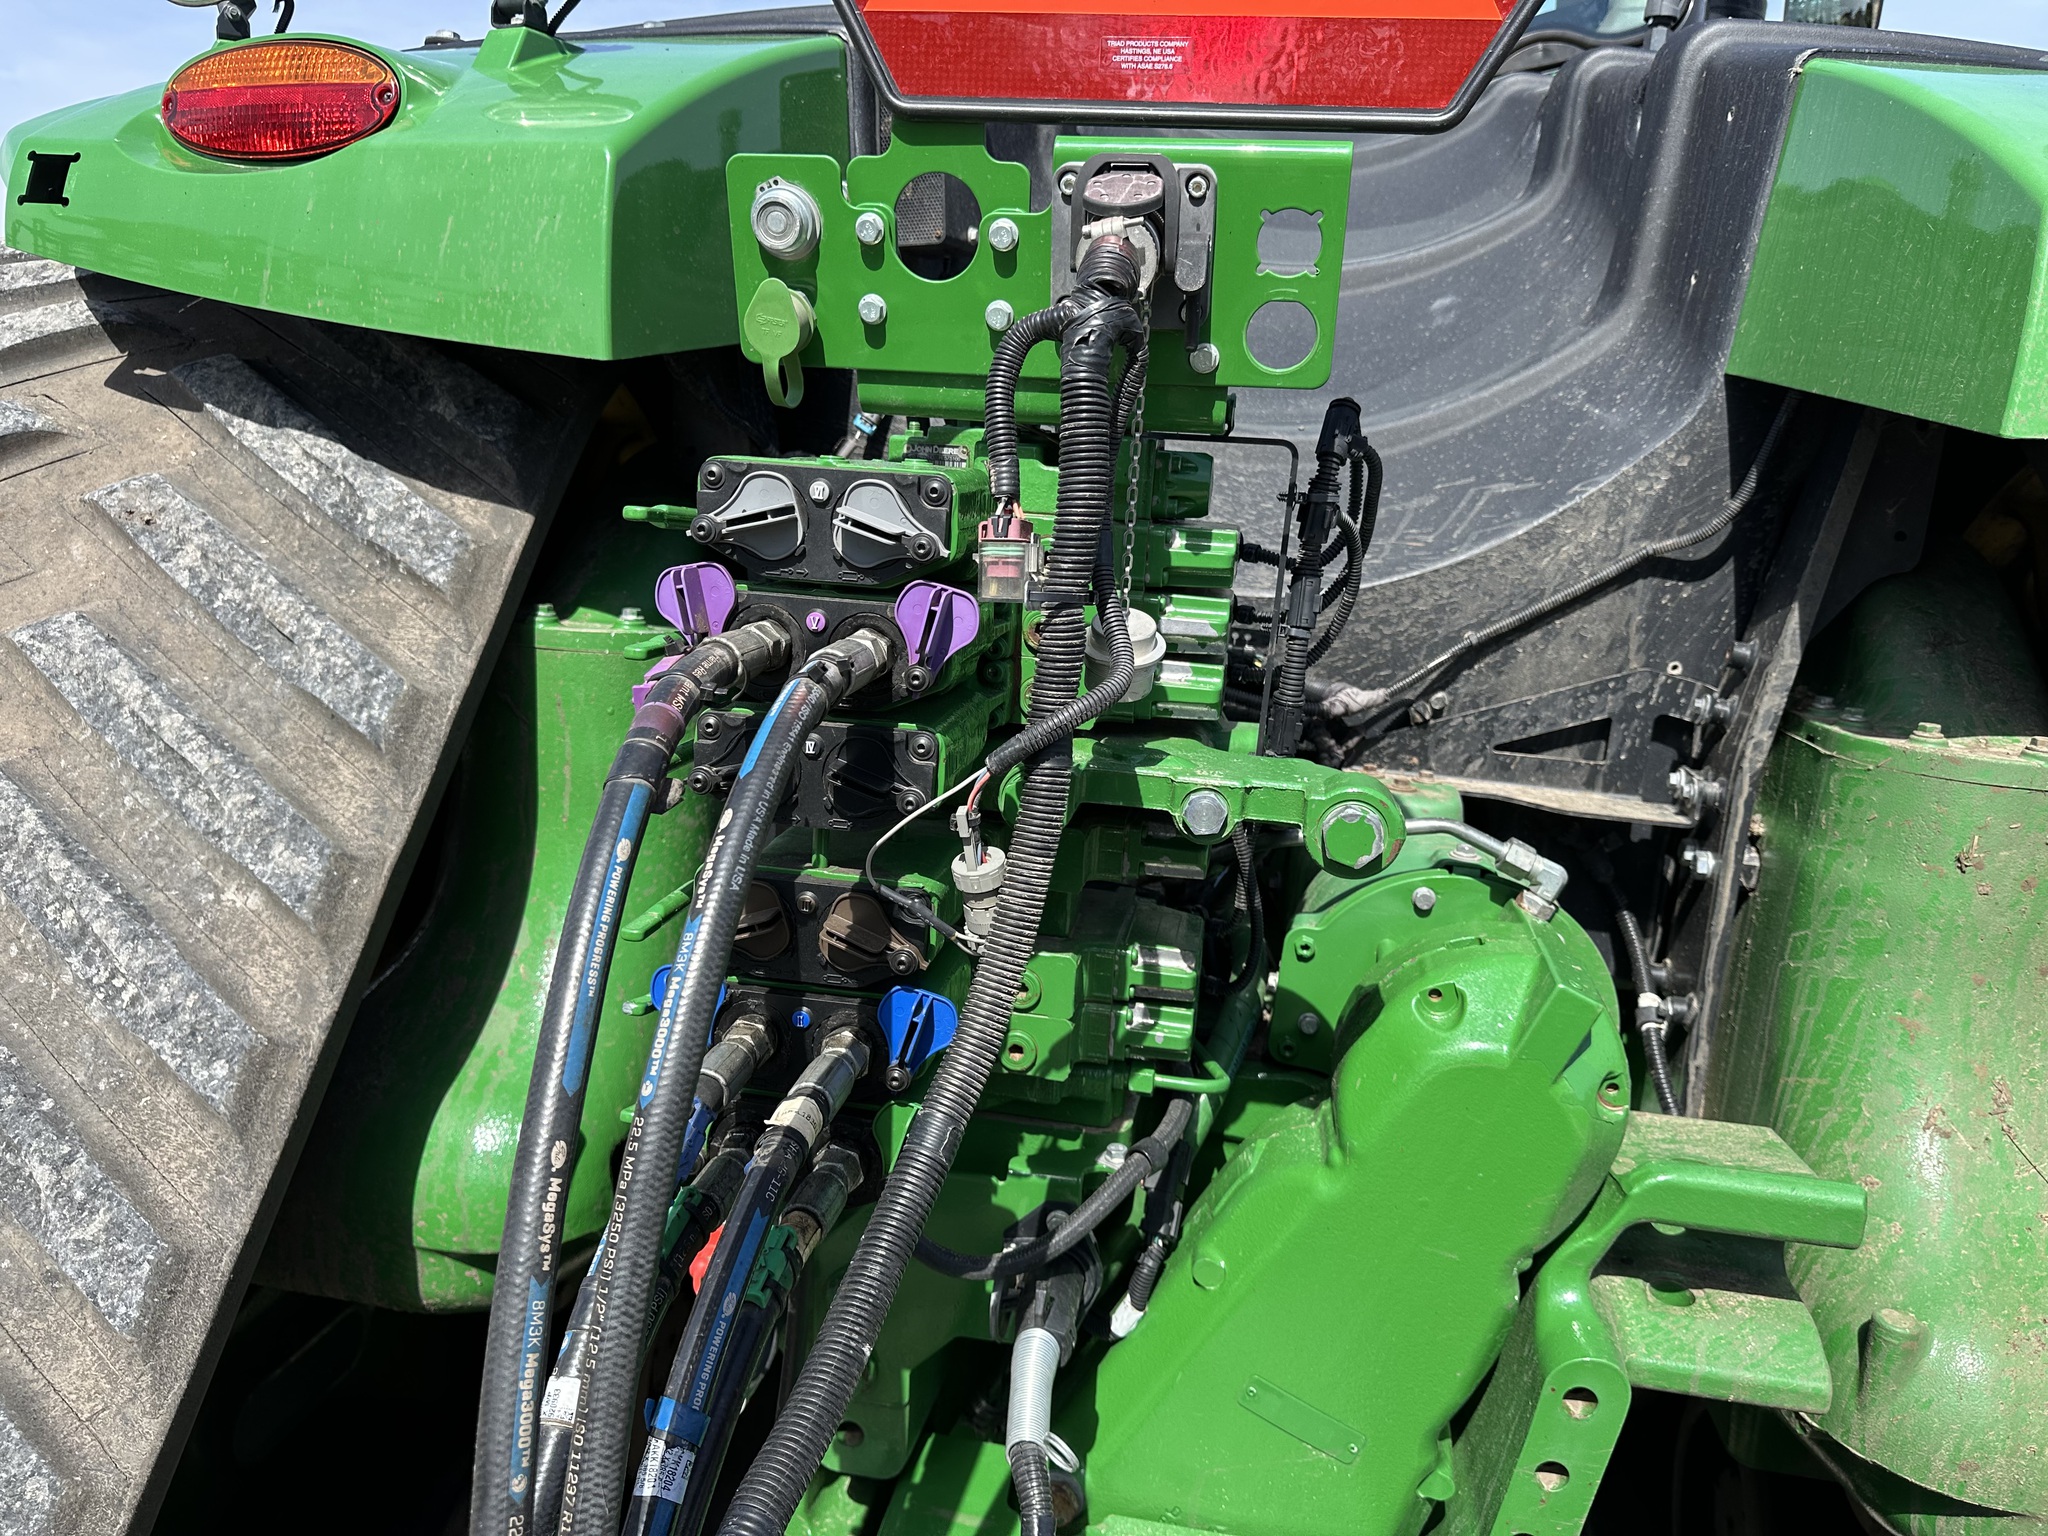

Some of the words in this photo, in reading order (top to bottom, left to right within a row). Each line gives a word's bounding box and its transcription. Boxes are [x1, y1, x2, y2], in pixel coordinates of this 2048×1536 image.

[814, 485, 825, 500] VI
[810, 616, 820, 630] V
[805, 741, 816, 754] IV
[754, 800, 769, 825] USA
[742, 821, 760, 852] Made
[738, 853, 750, 866] in
[729, 866, 746, 891] USA
[600, 865, 623, 923] POWERING
[801, 898, 811, 912] III
[673, 932, 694, 972] 8M3K
[796, 1015, 804, 1027] II
[628, 1116, 644, 1152] 22.5
[619, 1156, 636, 1190] MPa
[528, 1301, 545, 1348] 8M3K
[701, 1320, 726, 1380] POWERING
[573, 1417, 586, 1447] ISO
[565, 1451, 581, 1508] 11237
[560, 1510, 573, 1536] R1
